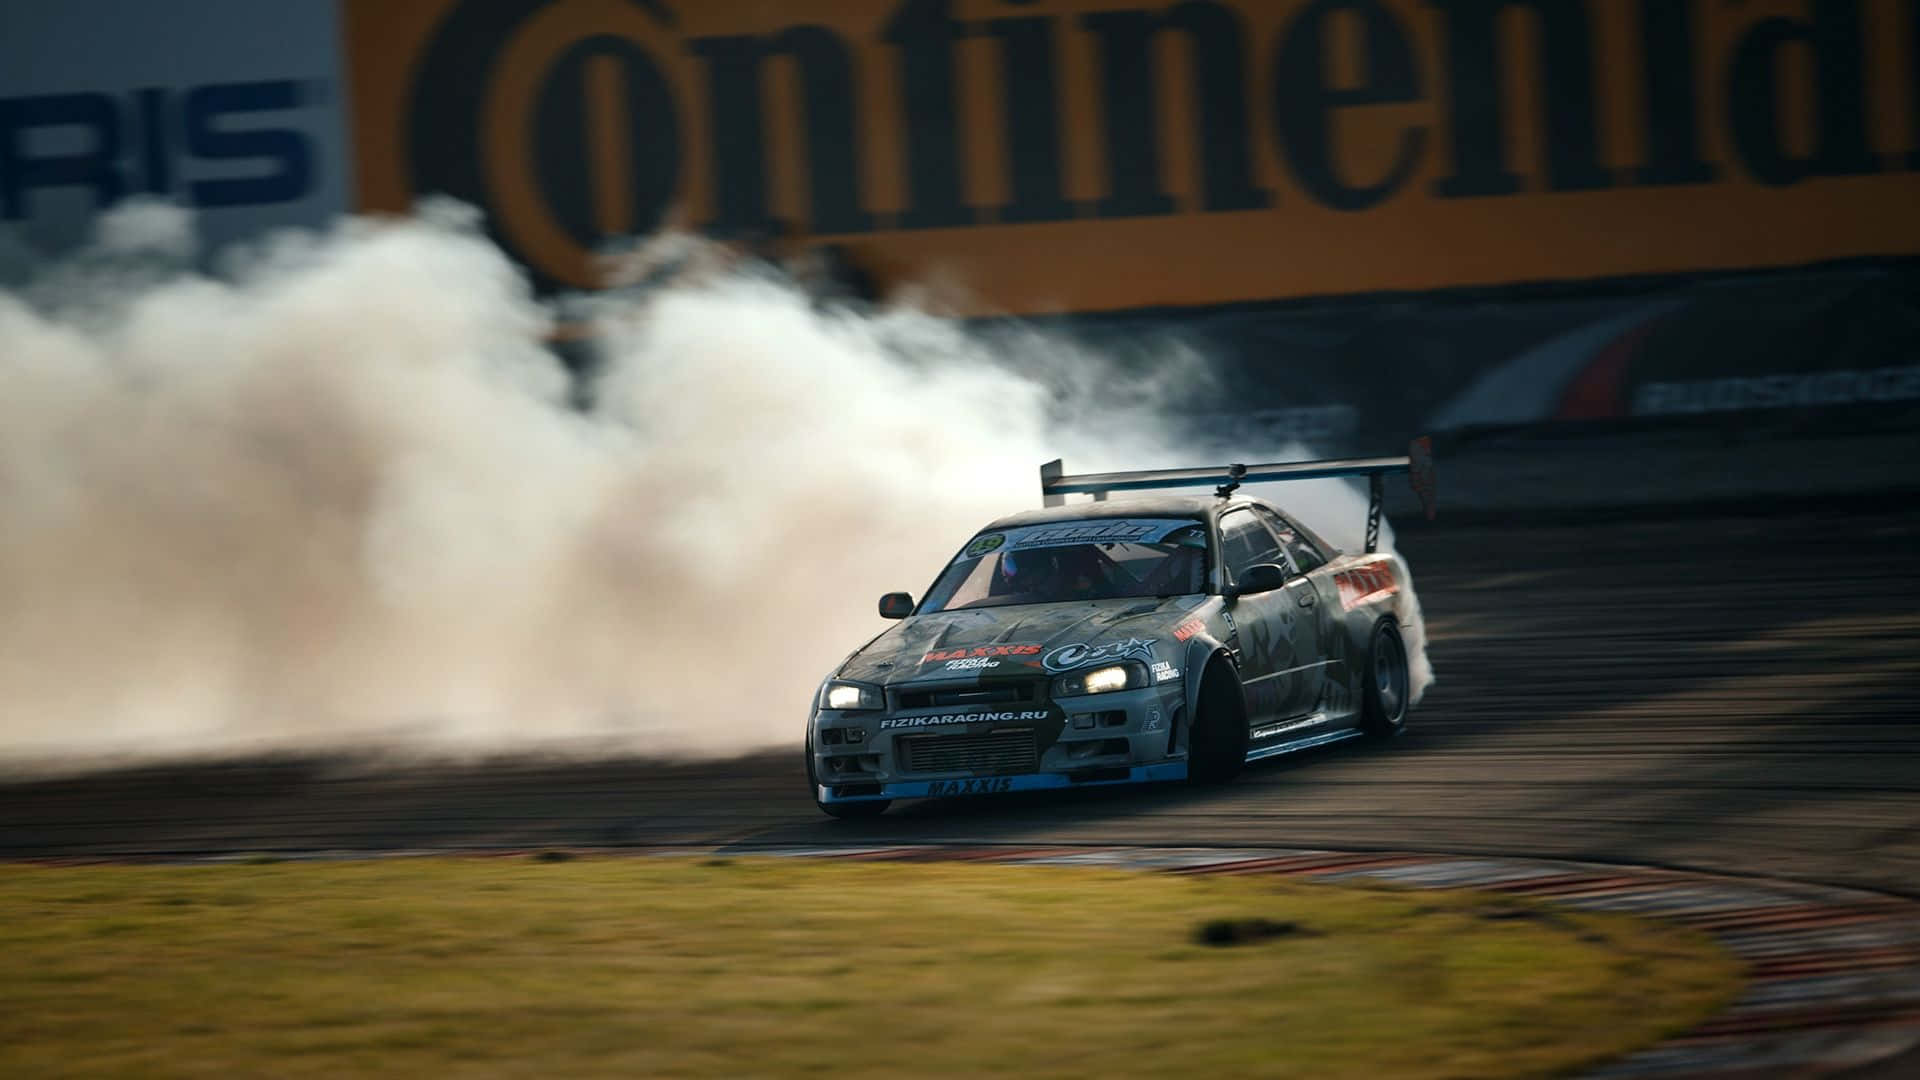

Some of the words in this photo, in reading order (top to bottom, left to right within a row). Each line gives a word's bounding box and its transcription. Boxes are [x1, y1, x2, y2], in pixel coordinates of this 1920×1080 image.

[405, 0, 1920, 300] Continenta
[924, 645, 1043, 662] MAXXIS
[880, 711, 1049, 729] FIZIKARACING.RU
[928, 777, 1013, 797] MAXXIS
